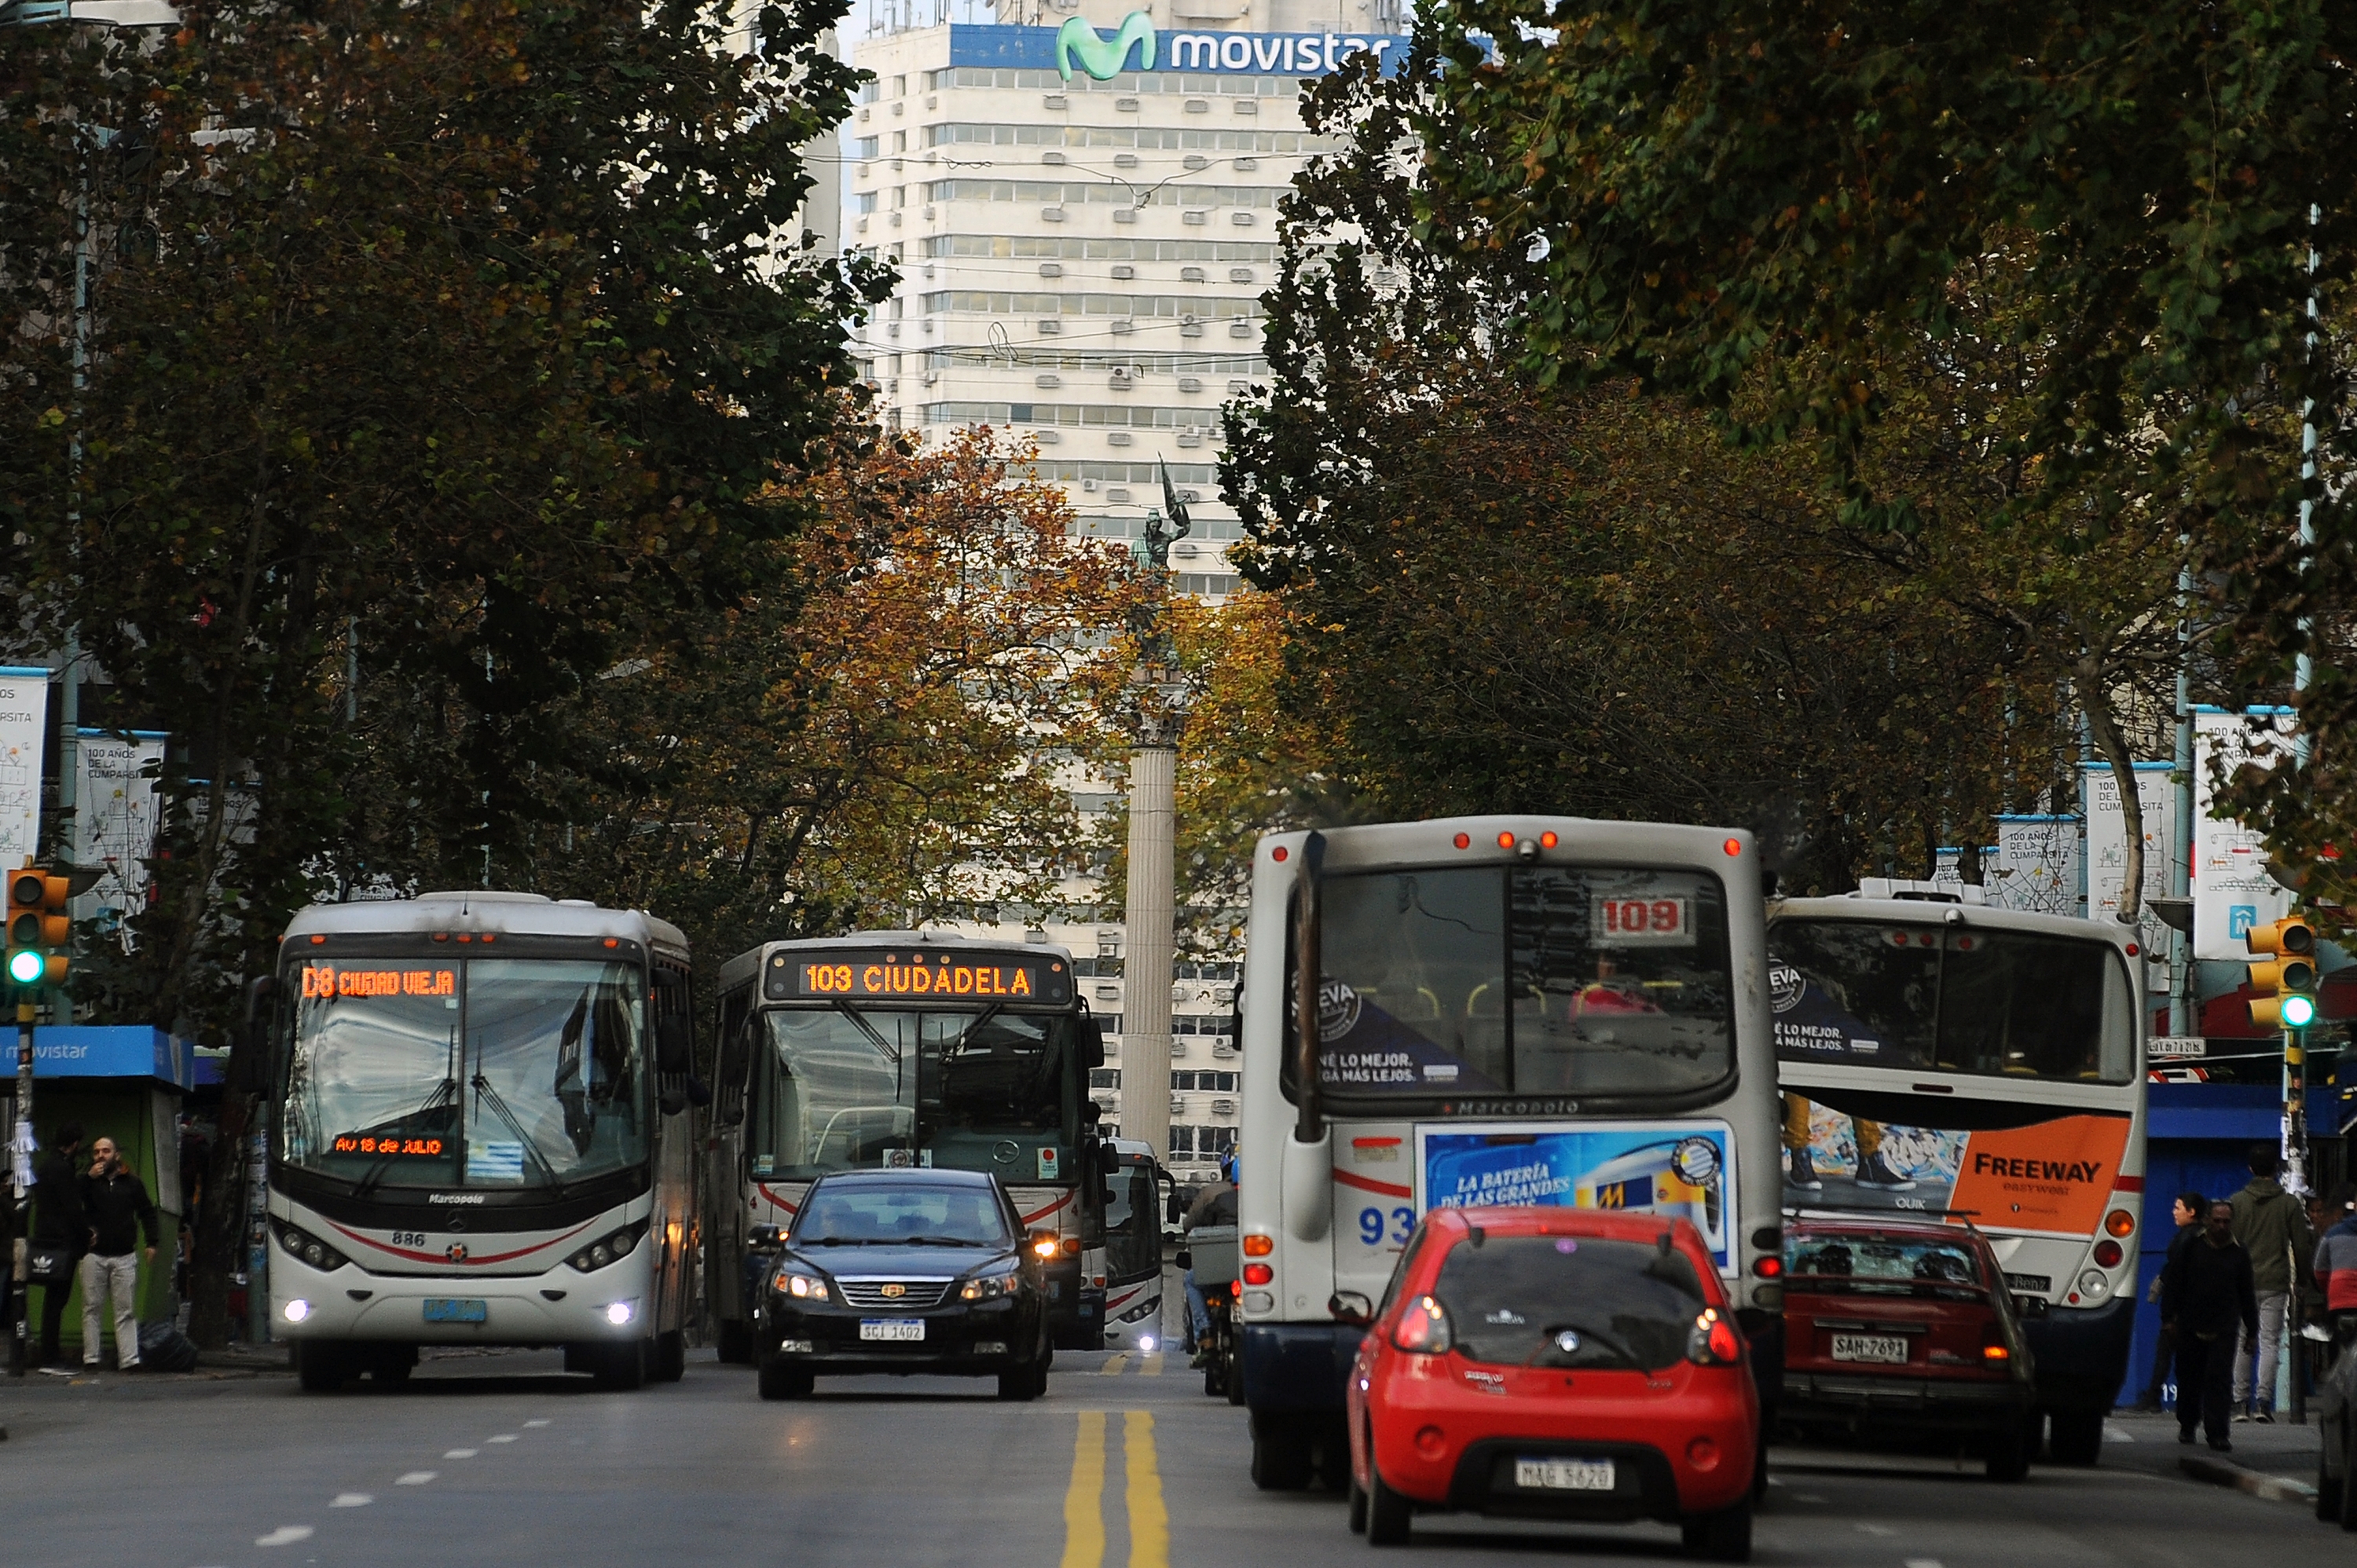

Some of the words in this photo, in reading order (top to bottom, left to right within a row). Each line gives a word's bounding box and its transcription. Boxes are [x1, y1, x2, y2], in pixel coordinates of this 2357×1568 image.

[88, 749, 104, 758] 100
[108, 747, 135, 759] AÑOS
[88, 760, 103, 768] DE
[88, 769, 140, 779] CUMPARSI
[2028, 830, 2054, 841] AÑOS
[1603, 901, 1678, 932] 109
[302, 967, 335, 997] D8
[339, 971, 400, 995] CIUDAD
[403, 970, 454, 995] VIEJA
[807, 965, 852, 992] 103
[863, 965, 1031, 995] CIUDADELA
[1784, 1024, 1799, 1035] LO
[1802, 1025, 1843, 1039] MEJOR.
[1785, 1035, 1807, 1048] MÁS
[1809, 1039, 1844, 1051] LEJOS.
[5, 1045, 88, 1059] mvistar
[1340, 1054, 1358, 1067] LO
[1361, 1053, 1413, 1068] MEJOR.
[1342, 1066, 1370, 1082] MÁS
[1373, 1069, 1416, 1083] LEJOS.
[379, 1139, 399, 1153] de
[402, 1139, 442, 1155] JULIO
[1974, 1153, 2102, 1182] FREEWAY
[1457, 1176, 1478, 1192] LA
[1482, 1160, 1549, 1189] BATERÍA
[1465, 1191, 1495, 1207] LAS
[1496, 1176, 1571, 1203] GRANDES
[429, 1194, 486, 1205] Marcopolo
[392, 1232, 425, 1247] 886
